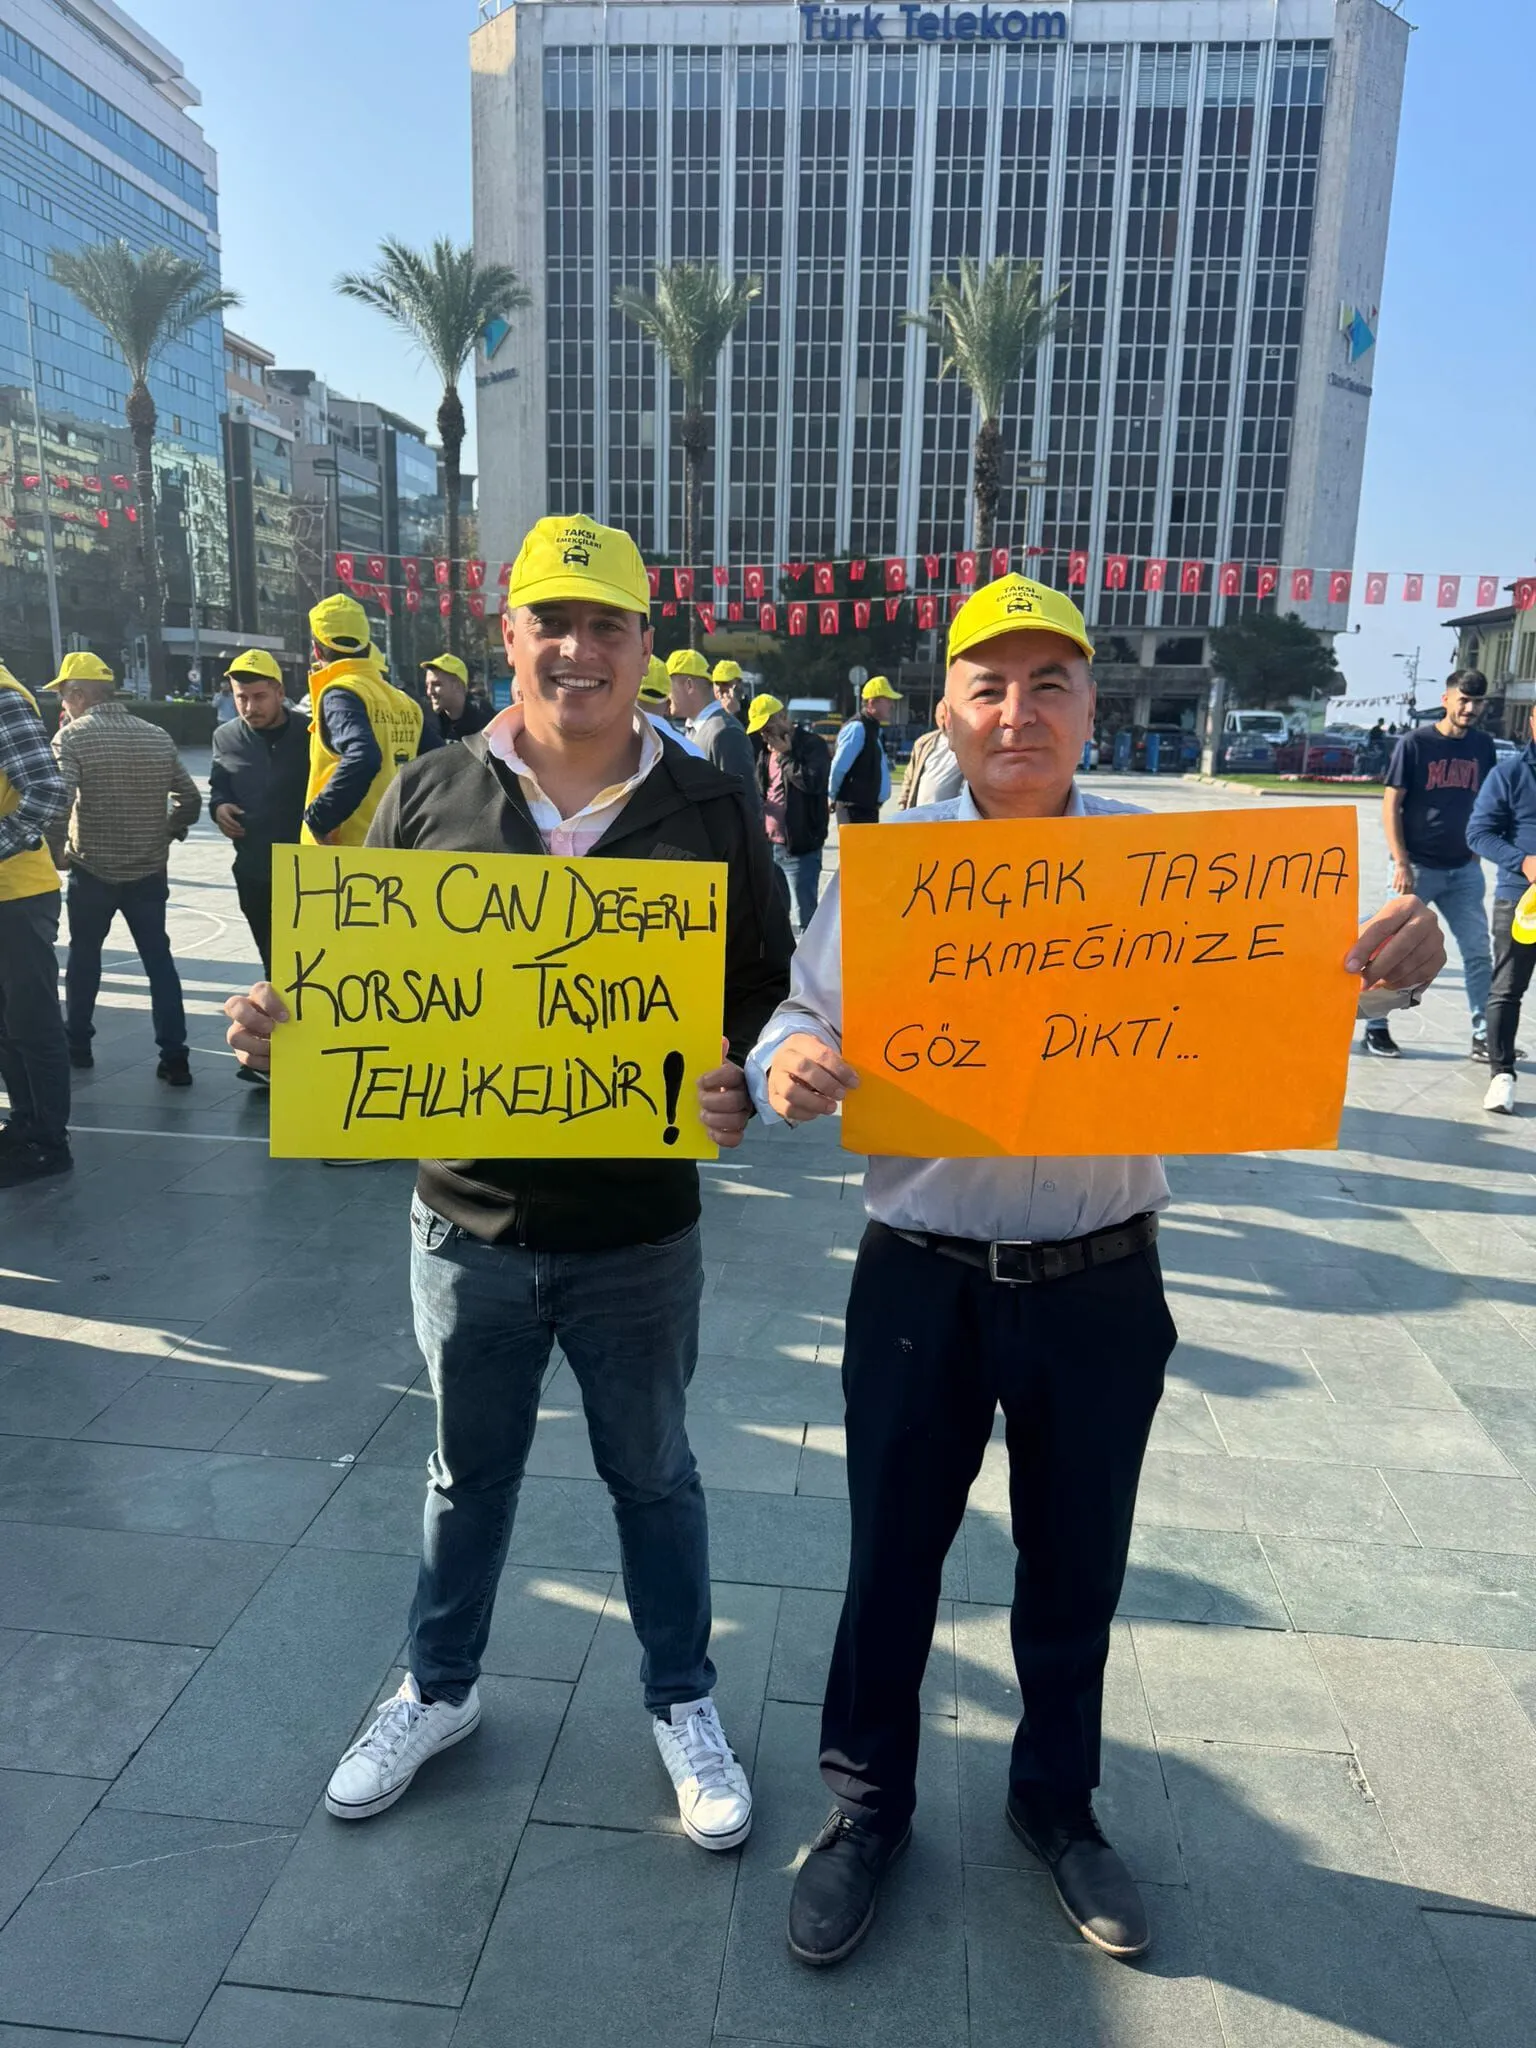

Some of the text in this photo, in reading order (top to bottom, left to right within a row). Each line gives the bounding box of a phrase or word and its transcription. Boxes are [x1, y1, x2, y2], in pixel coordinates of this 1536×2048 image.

[801, 4, 1066, 41] Türk Telekom
[293, 855, 717, 961] HER CAN DEĞERLİ
[902, 847, 1349, 918] KAÇAK TAŞIMA
[929, 922, 1285, 984] EKMEĞİMİZE
[285, 948, 679, 1034] KORSAN TAŞIMA
[884, 1005, 1199, 1073] GÖZ DİKTİ...
